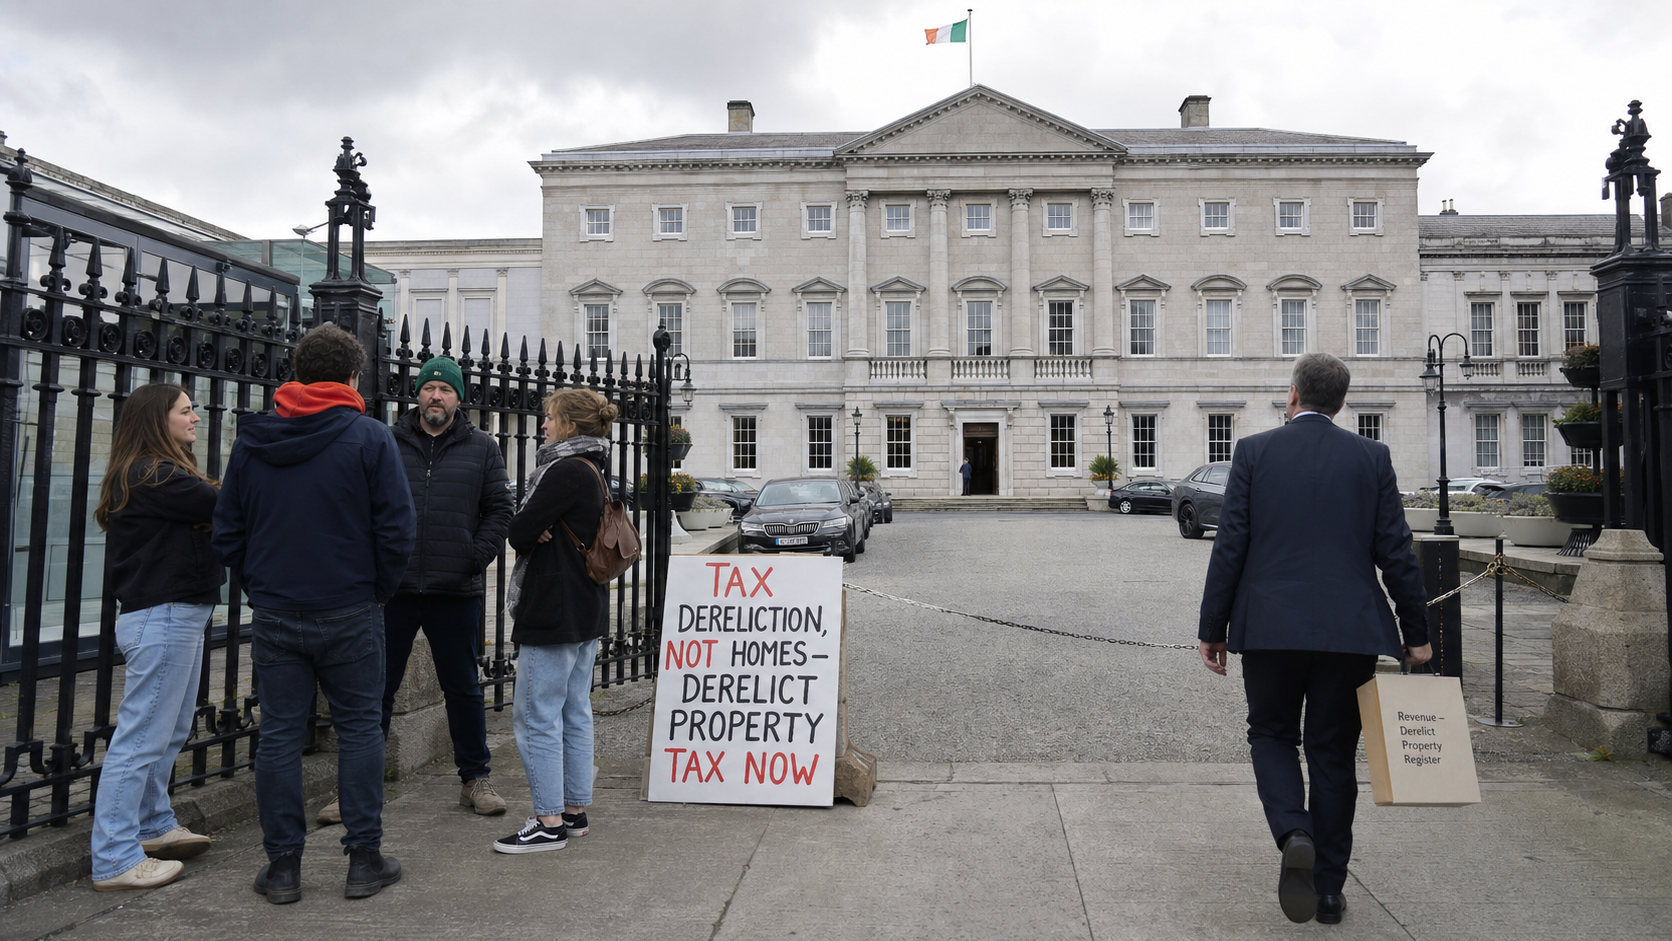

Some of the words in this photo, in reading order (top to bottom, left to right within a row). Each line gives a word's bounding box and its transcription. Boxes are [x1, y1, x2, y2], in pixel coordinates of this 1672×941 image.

[705, 562, 774, 598] TAX
[677, 604, 828, 637] DERELICTION,
[665, 639, 719, 671] NOT
[682, 673, 818, 705] DERELICT
[669, 709, 824, 744] PROPERTY
[1400, 726, 1436, 736] Derelict
[1402, 740, 1443, 752] Property
[1404, 754, 1442, 767] Register
[664, 748, 725, 783] TAX
[744, 751, 820, 786] NOW
